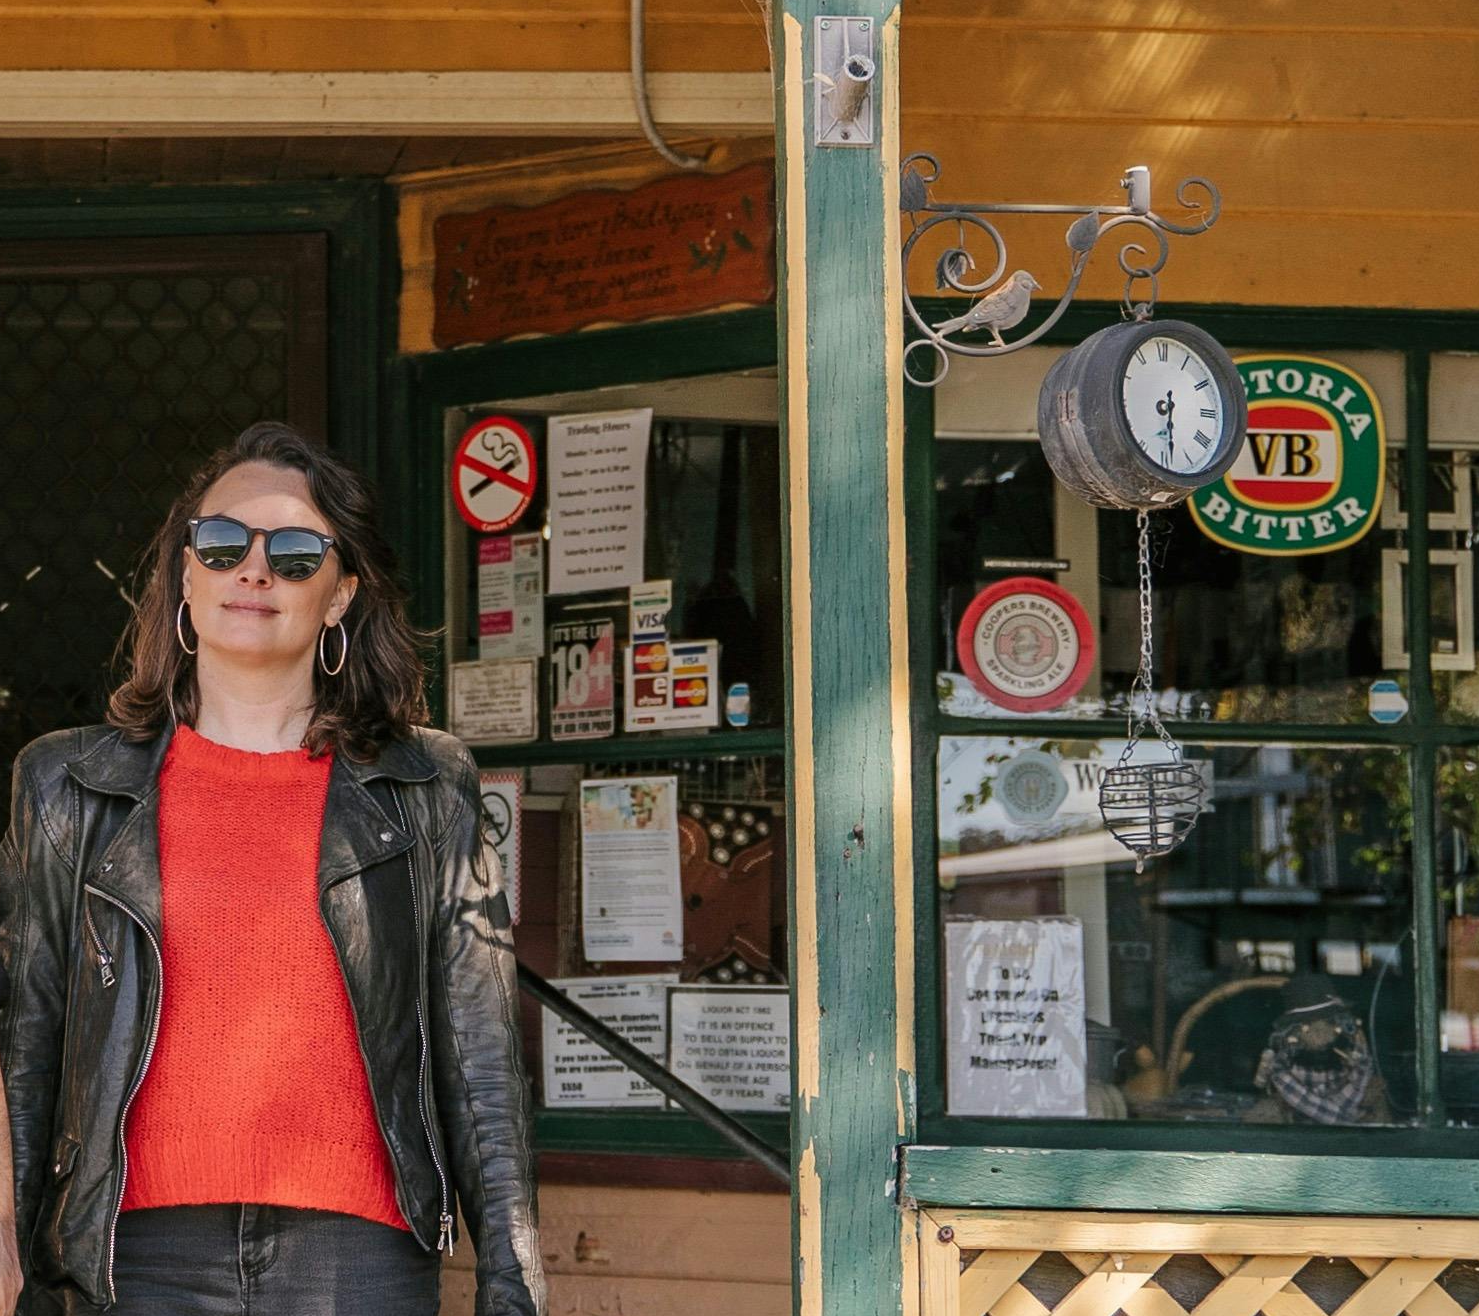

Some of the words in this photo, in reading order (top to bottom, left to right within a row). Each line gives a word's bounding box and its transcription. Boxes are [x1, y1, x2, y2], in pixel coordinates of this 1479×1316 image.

[1246, 433, 1321, 477] VB
[1200, 491, 1368, 541] BITTER
[982, 600, 1026, 640] COOPERS
[1029, 600, 1072, 645] BREWERY
[986, 657, 1046, 690] SPARKLING
[1047, 662, 1066, 681] ALE
